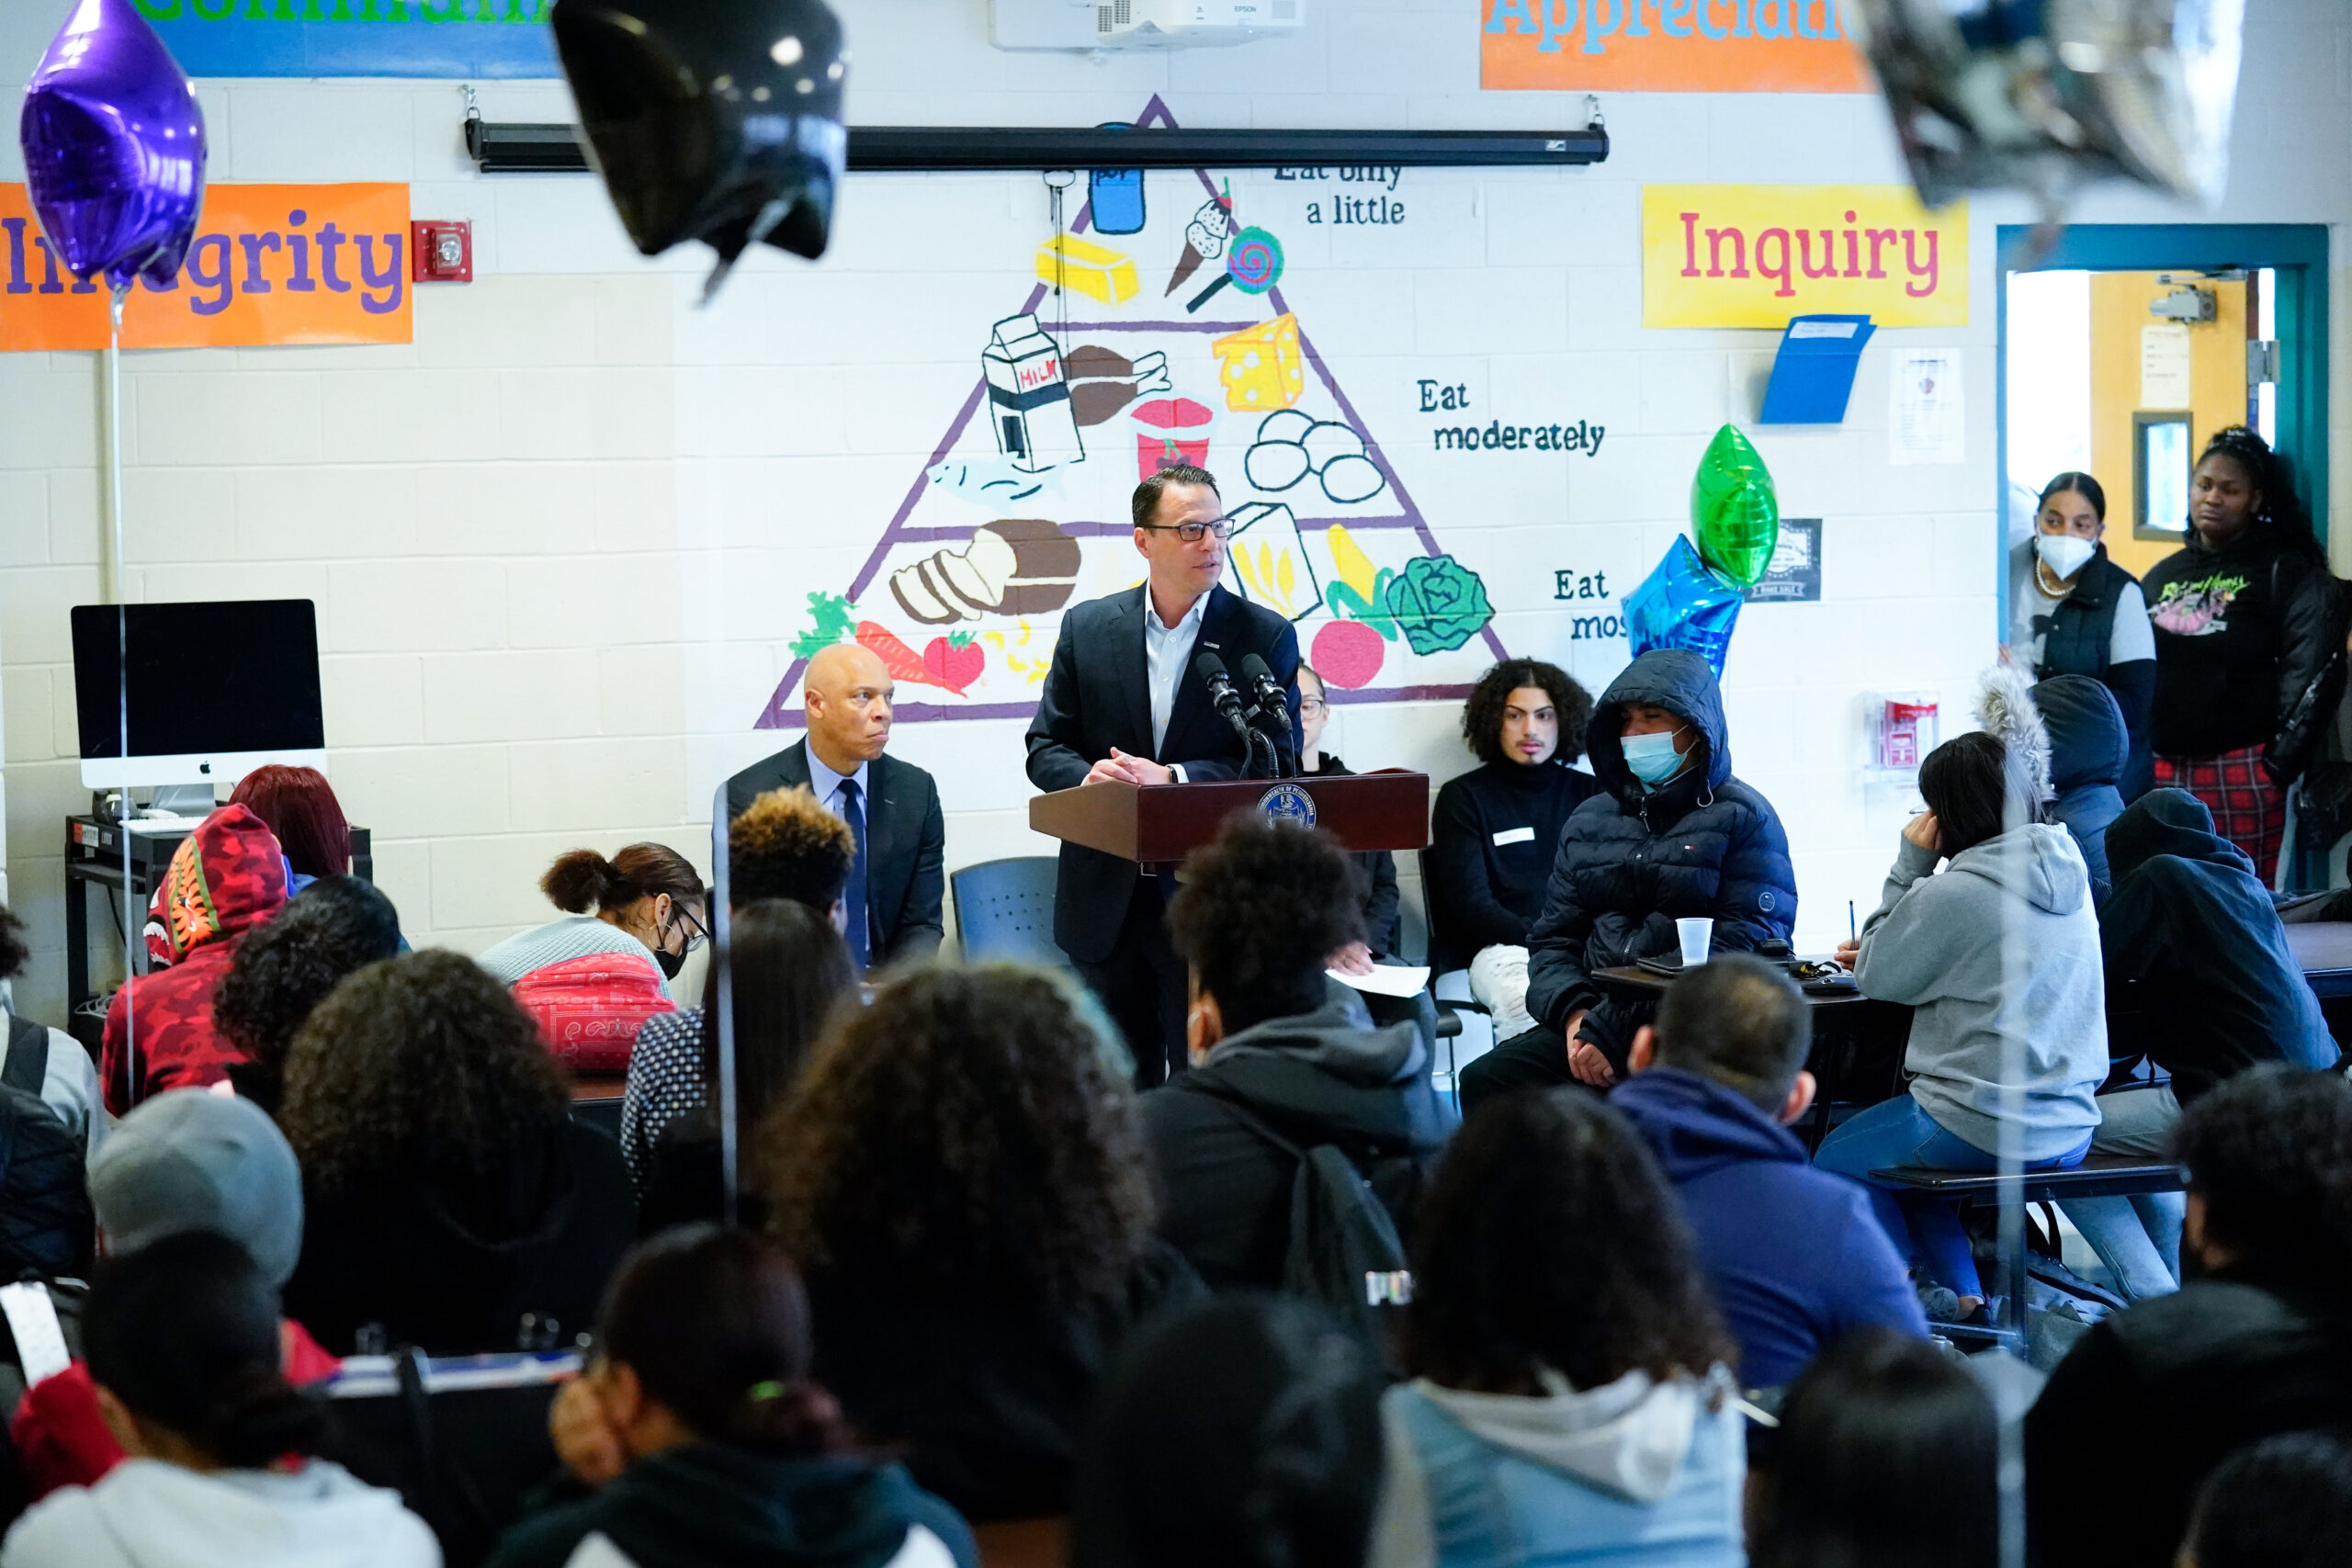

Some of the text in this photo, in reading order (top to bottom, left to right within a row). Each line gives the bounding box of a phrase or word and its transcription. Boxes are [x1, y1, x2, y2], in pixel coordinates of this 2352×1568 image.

[1306, 195, 1405, 224] a little
[1, 209, 403, 316] Igrity
[1679, 209, 1938, 298] Inquiry
[1020, 358, 1056, 390] MILK
[1417, 379, 1470, 412] Eat
[1434, 419, 1605, 457] moderately
[1554, 569, 1610, 600] Eat
[1570, 615, 1628, 640] mos
